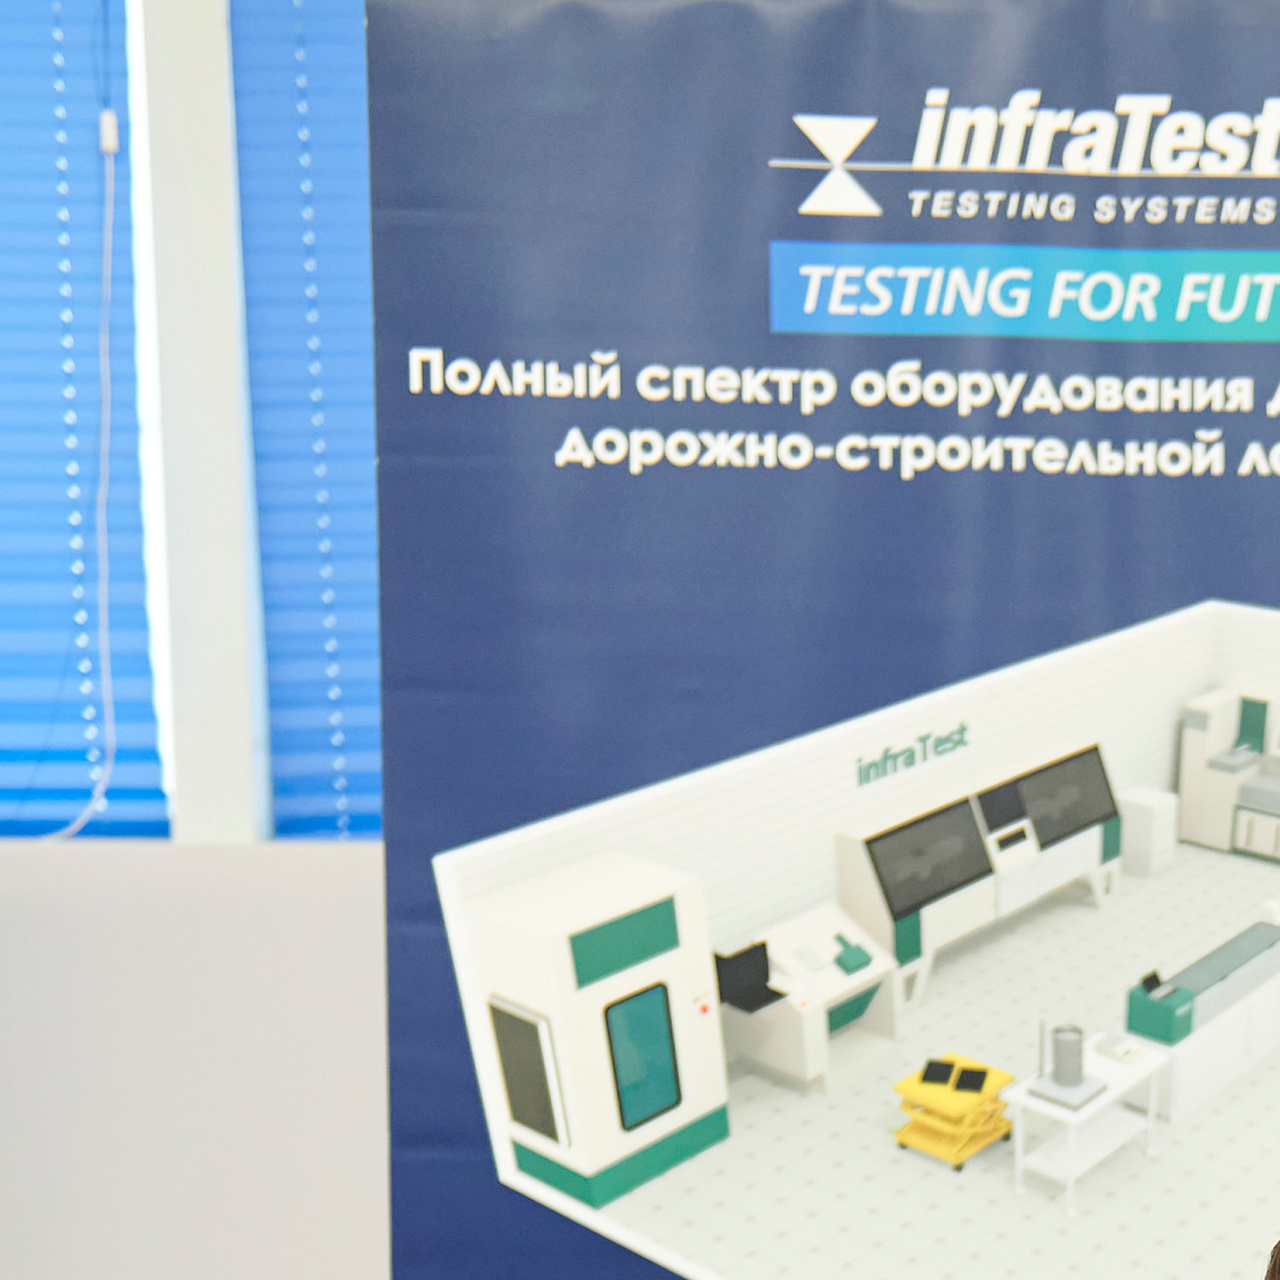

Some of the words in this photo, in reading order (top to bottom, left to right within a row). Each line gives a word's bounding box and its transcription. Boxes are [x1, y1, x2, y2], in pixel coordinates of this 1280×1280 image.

[907, 190, 1077, 221] TESTING
[1092, 194, 1278, 225] SYSTEMS
[798, 263, 1034, 318] TESTING
[1046, 269, 1163, 322] FOR
[408, 346, 622, 401] Полный
[635, 363, 838, 416] спектр
[850, 358, 1256, 418] оборудования
[553, 426, 1226, 482] дорожно-строительной
